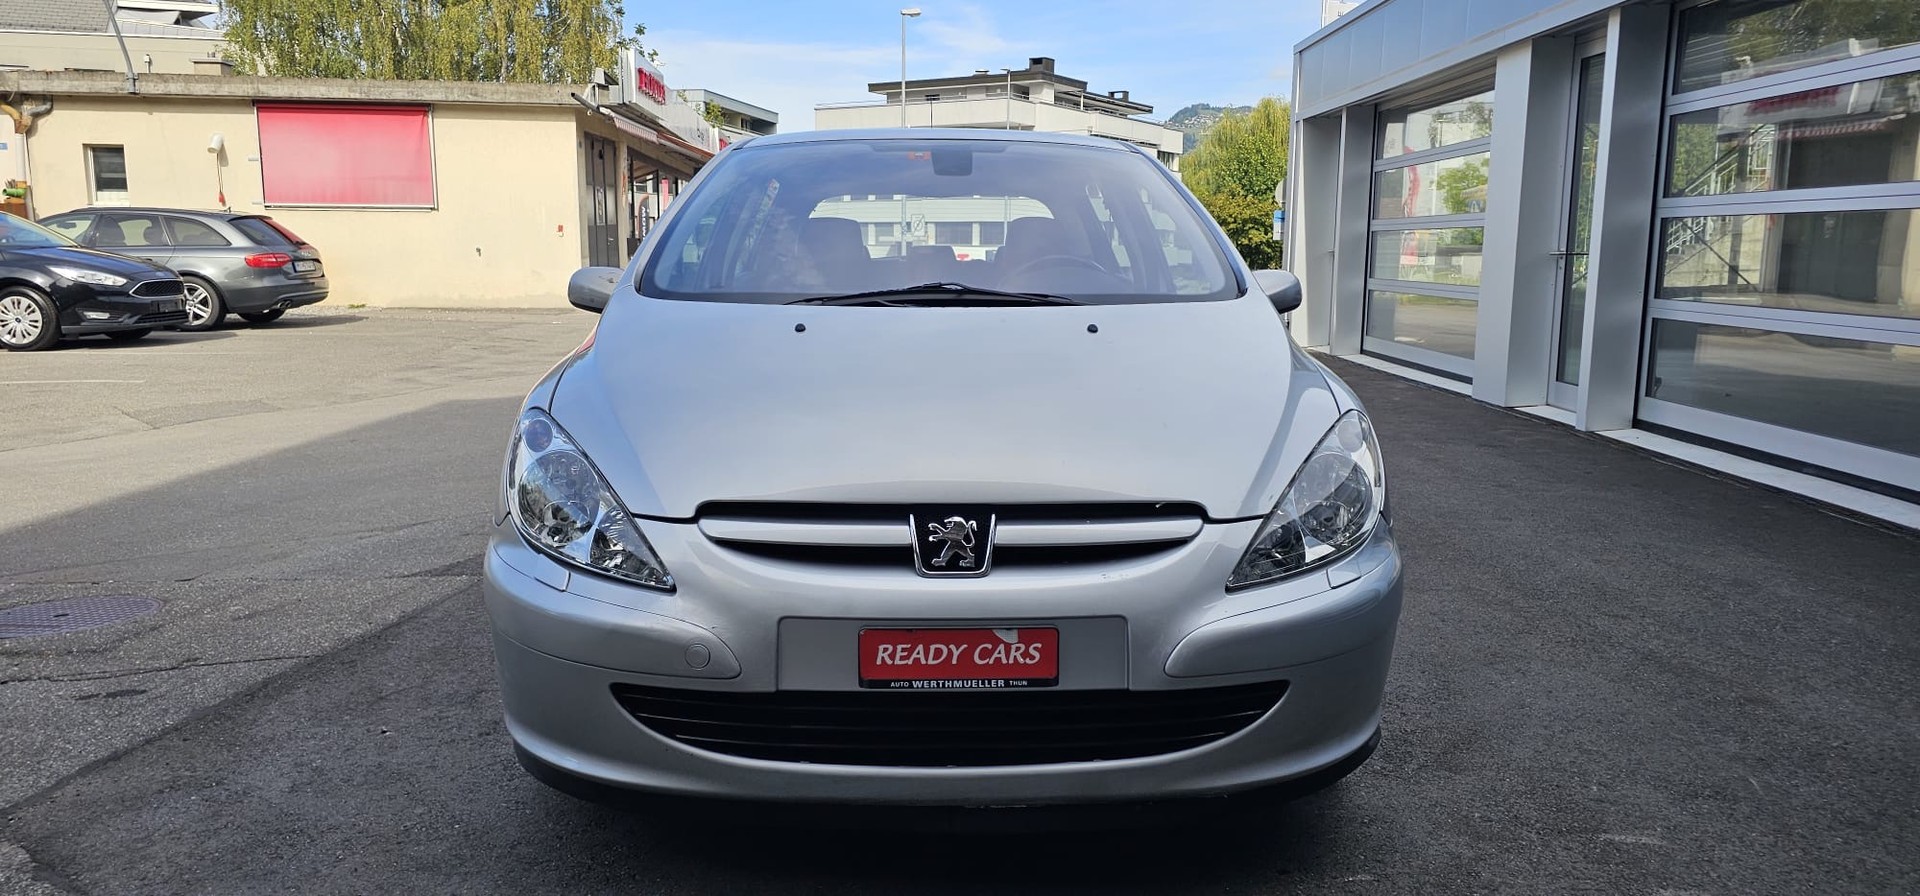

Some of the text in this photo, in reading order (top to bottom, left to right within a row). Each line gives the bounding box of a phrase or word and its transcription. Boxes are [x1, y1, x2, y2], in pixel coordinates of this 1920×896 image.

[876, 643, 1042, 665] READY CARS
[912, 680, 1005, 688] WERTHMUELLER
